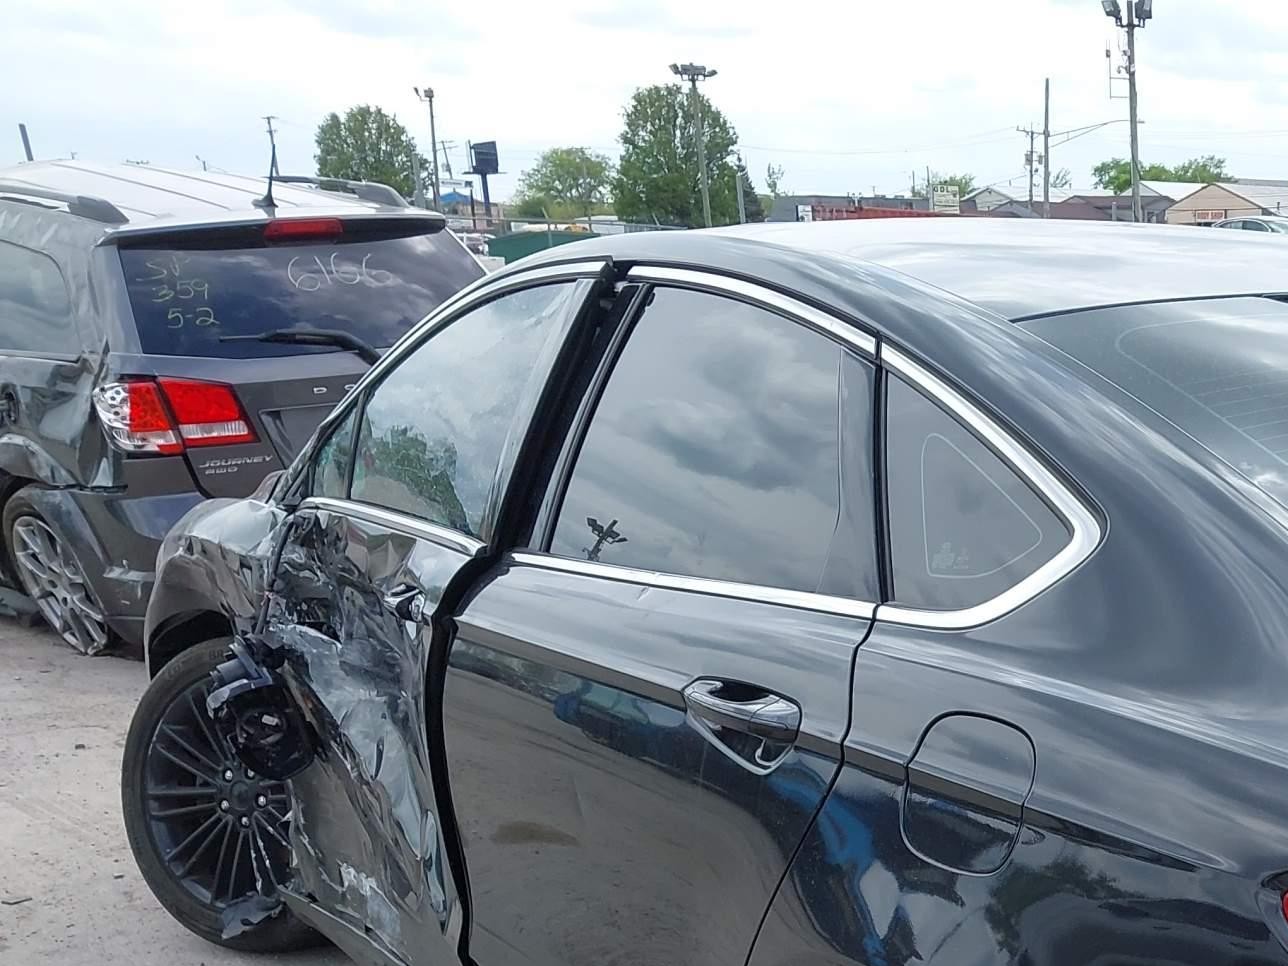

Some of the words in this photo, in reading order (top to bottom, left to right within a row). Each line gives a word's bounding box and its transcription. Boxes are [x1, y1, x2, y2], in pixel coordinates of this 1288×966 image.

[287, 252, 393, 292] 6166
[152, 278, 208, 302] 359
[167, 307, 220, 329] 5-2
[199, 455, 273, 468] JOURNEY
[204, 466, 239, 475] AWD
